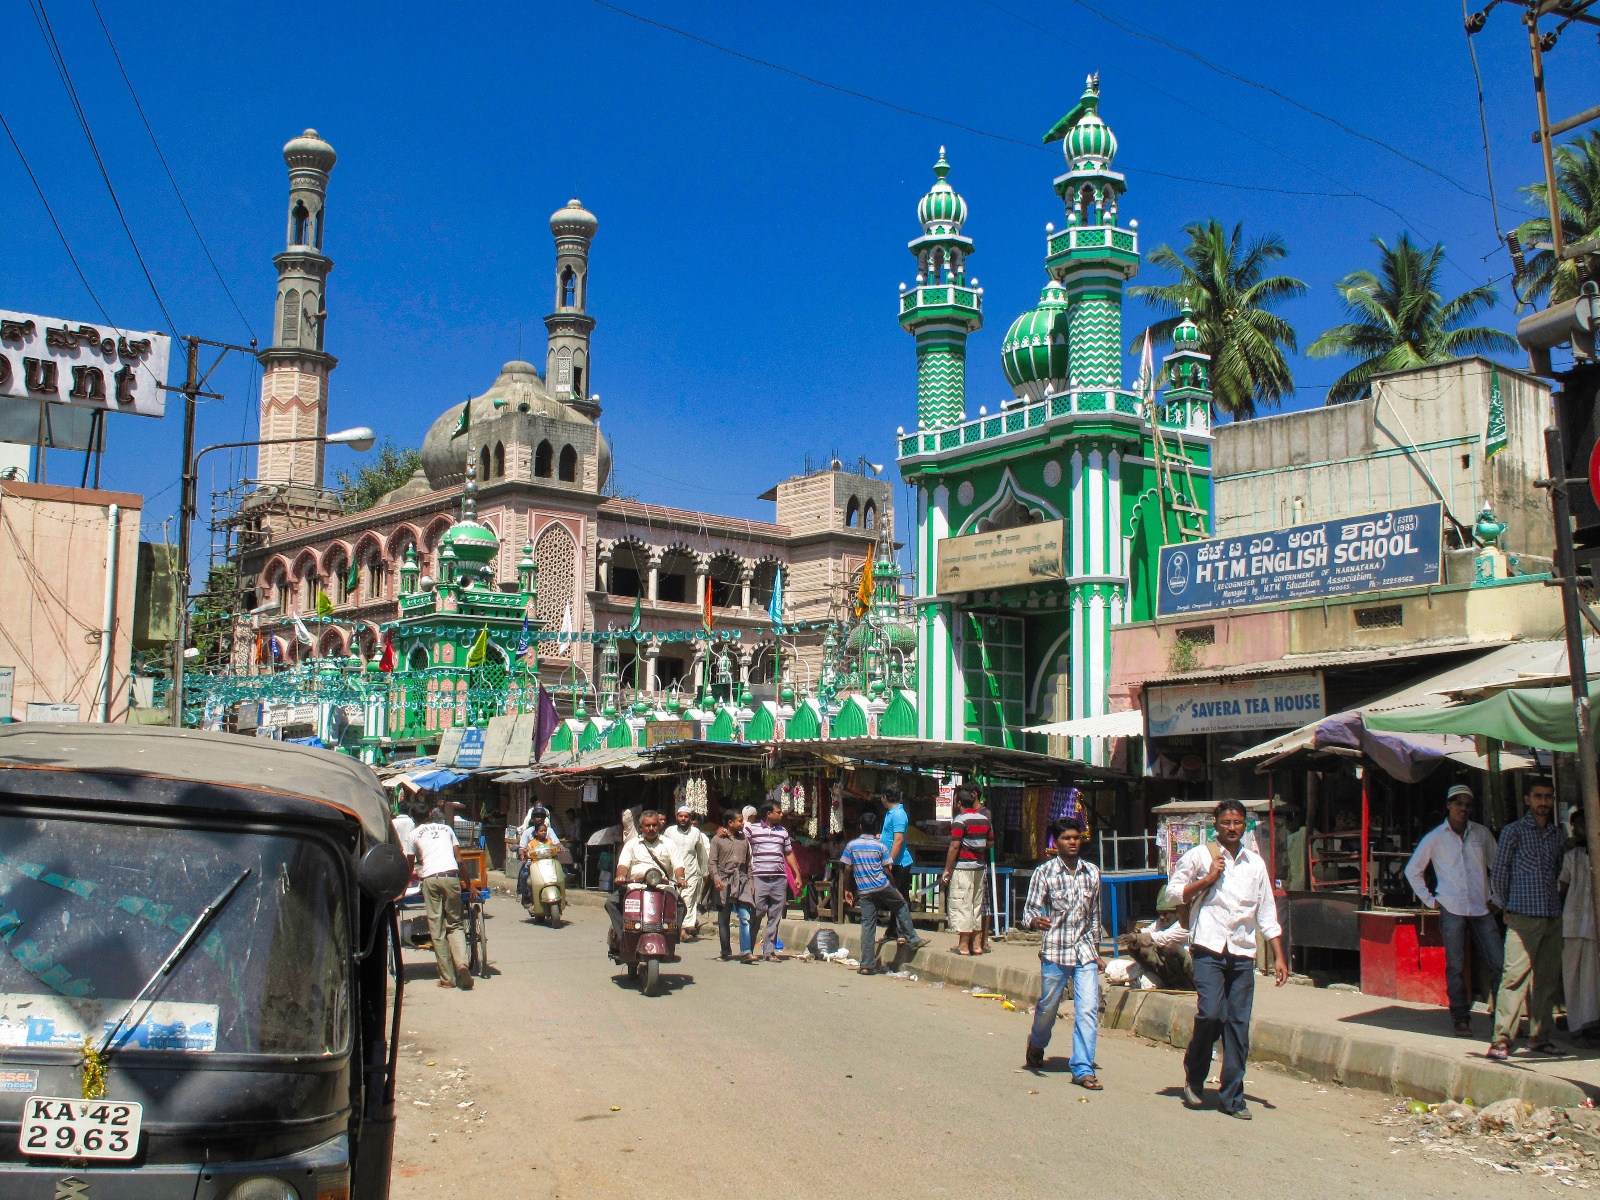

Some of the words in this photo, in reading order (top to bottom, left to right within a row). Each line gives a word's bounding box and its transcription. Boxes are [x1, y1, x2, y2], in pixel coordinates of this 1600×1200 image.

[1341, 513, 1393, 540] ಶಾಲೆ
[1251, 546, 1328, 575] ENGLISH
[1334, 533, 1419, 564] SCHOOL
[1222, 587, 1248, 598] Managed
[1251, 586, 1259, 596] by
[1263, 583, 1281, 593] HTM
[1285, 578, 1321, 590] Education
[1273, 570, 1314, 583] GOVERNMENT
[1320, 568, 1330, 577] OF
[1191, 699, 1242, 719] SAVERA
[1245, 697, 1270, 714] TEA
[1274, 693, 1321, 713] HOUSE
[32, 1101, 77, 1121] KA
[89, 1105, 131, 1127] 42
[27, 1125, 130, 1153] 2963
